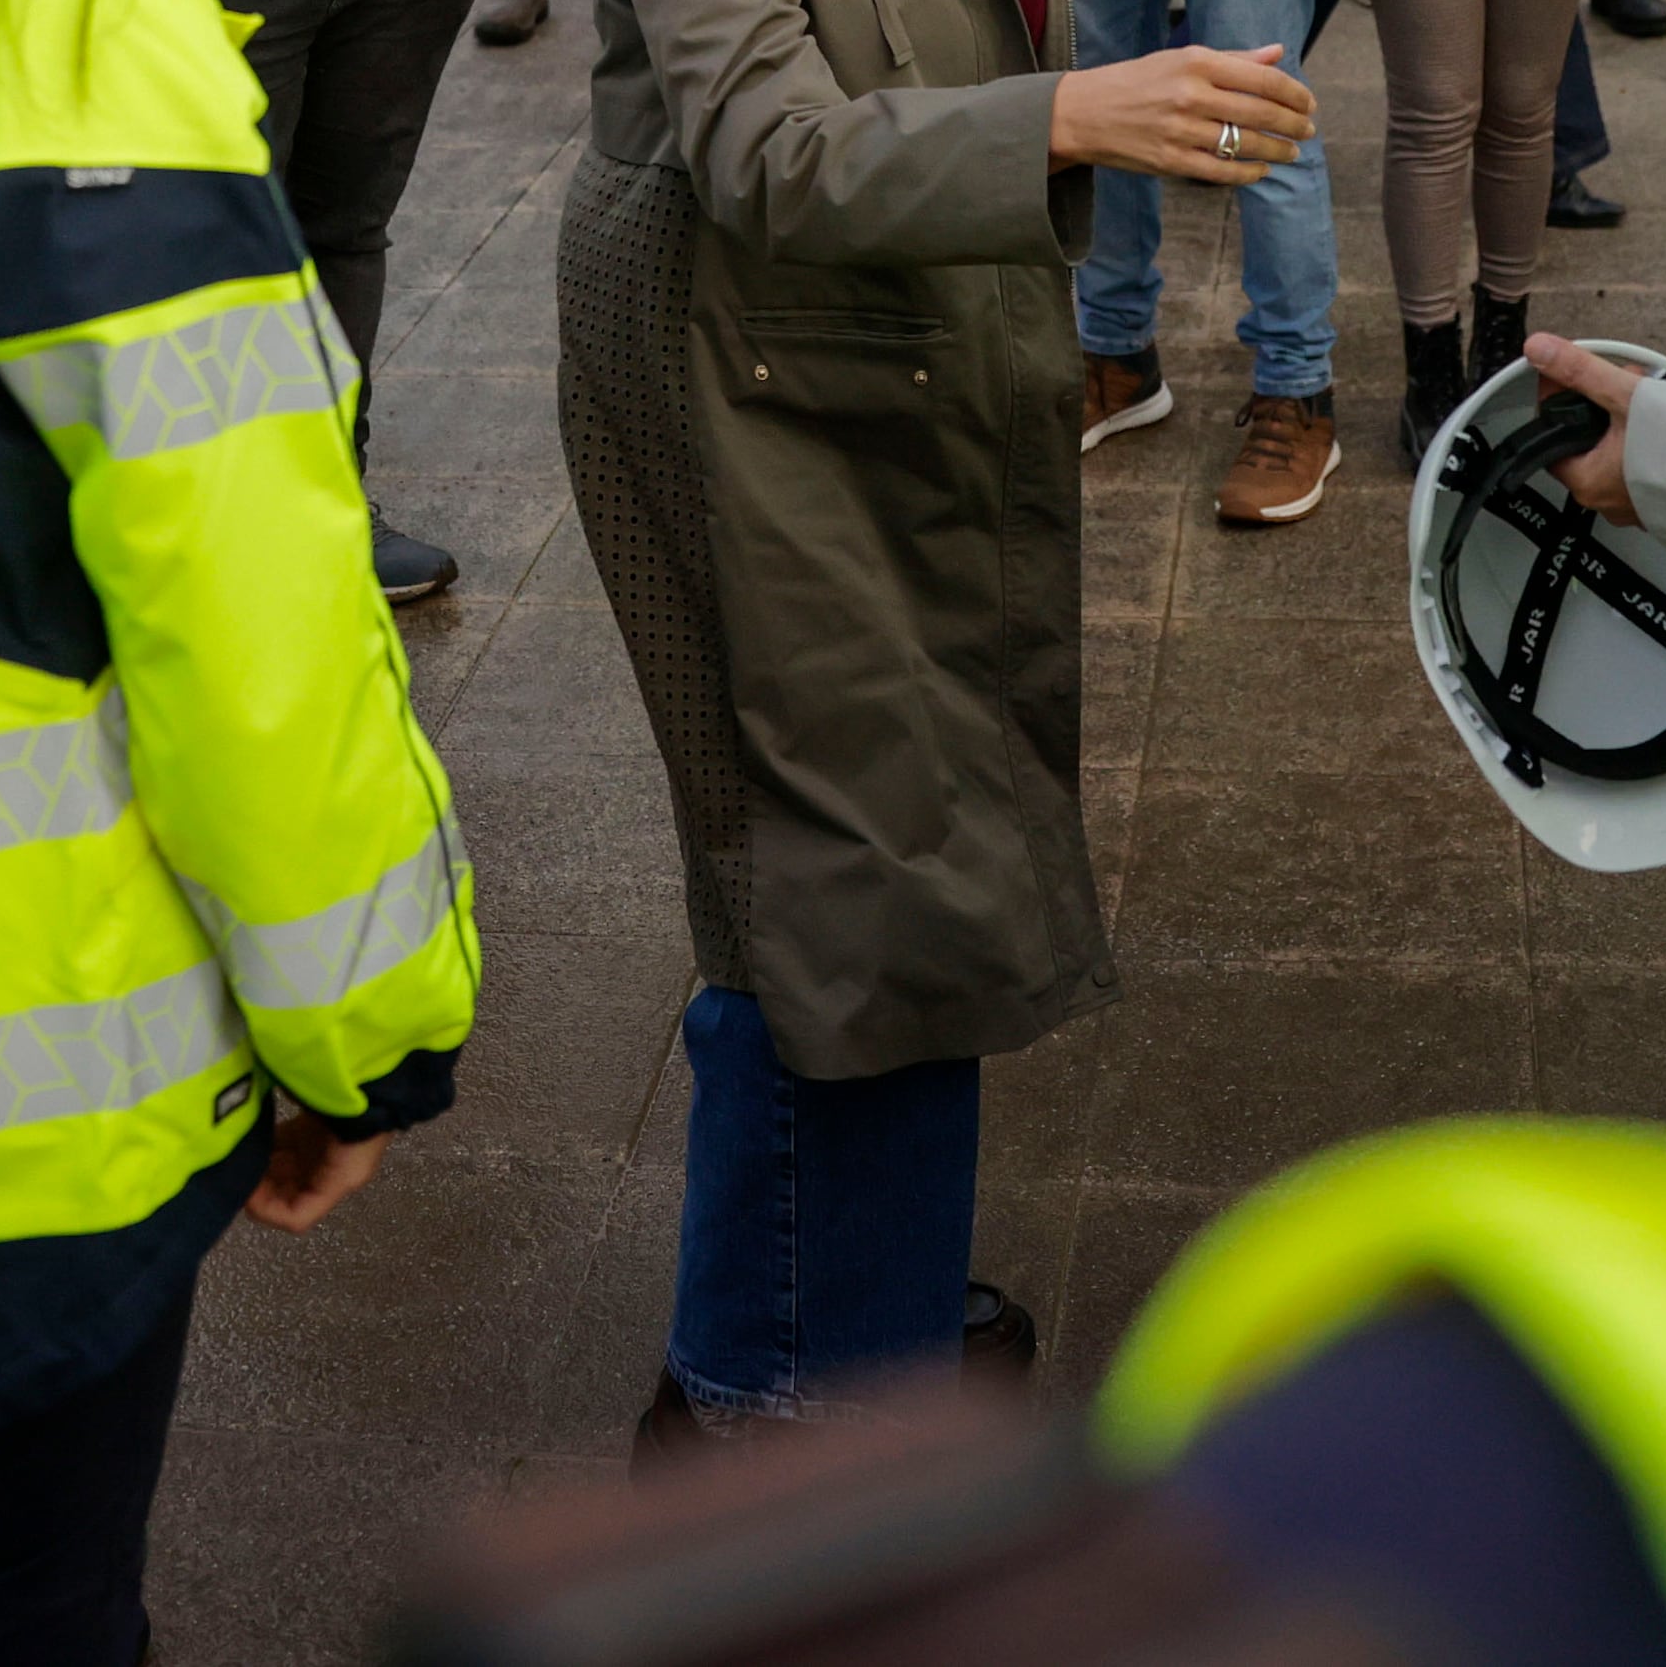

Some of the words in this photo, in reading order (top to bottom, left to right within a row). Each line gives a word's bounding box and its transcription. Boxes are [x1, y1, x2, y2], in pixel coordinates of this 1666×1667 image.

[1509, 499, 1547, 530] JAR
[1520, 607, 1546, 665] JAR
[1546, 535, 1577, 588] JAR
